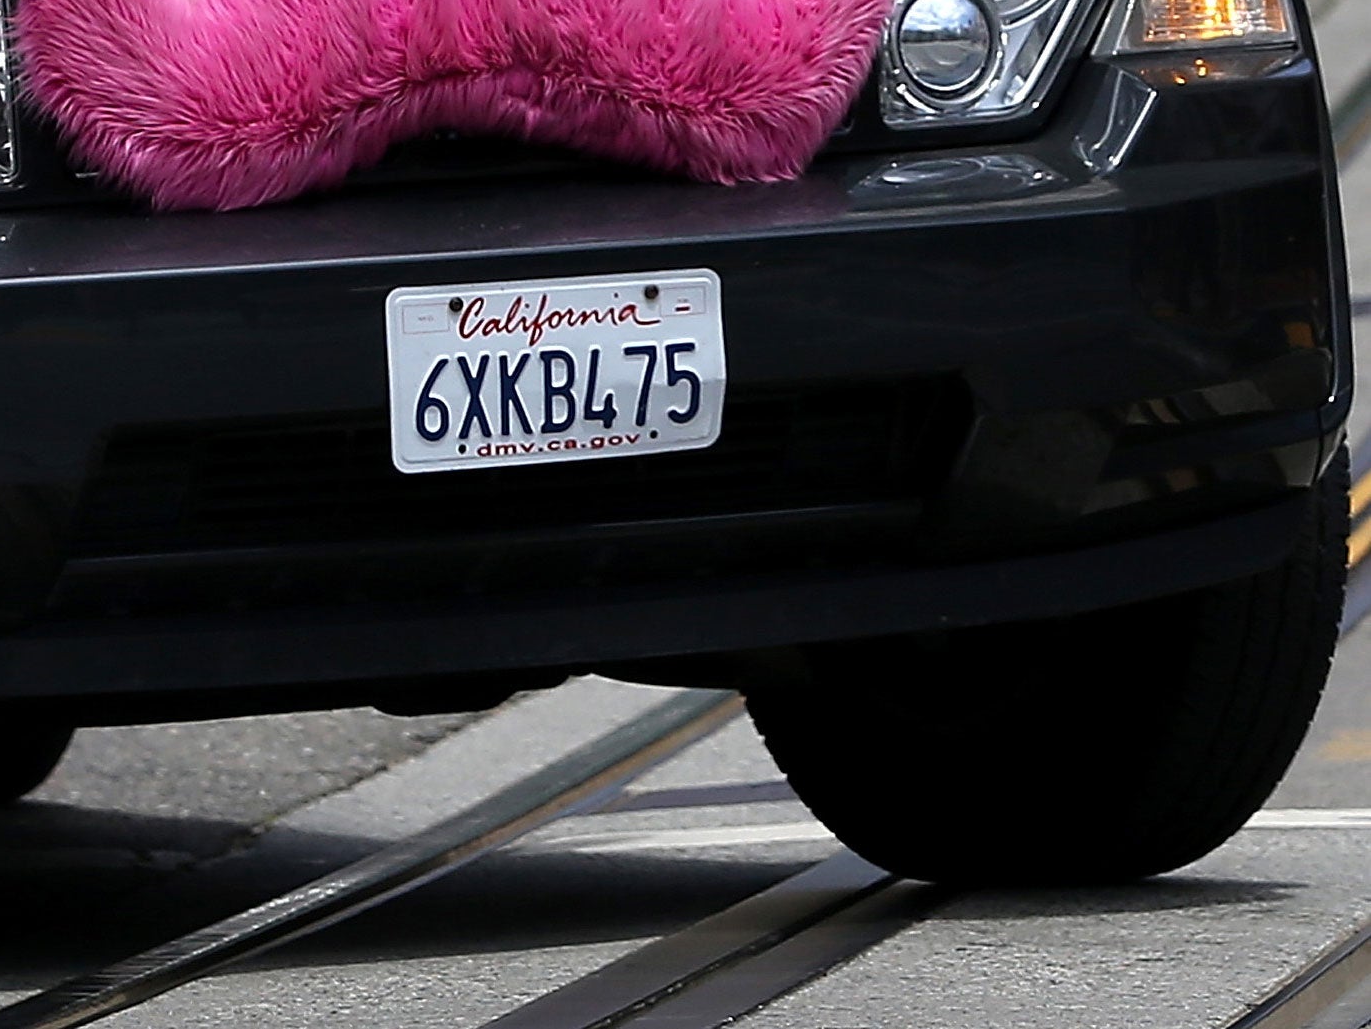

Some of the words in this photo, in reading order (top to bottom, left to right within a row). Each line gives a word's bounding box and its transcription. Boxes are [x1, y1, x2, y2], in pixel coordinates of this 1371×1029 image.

[459, 295, 661, 347] California
[415, 343, 701, 442] 6XKB475
[477, 432, 641, 457] dmv.ca.gov
